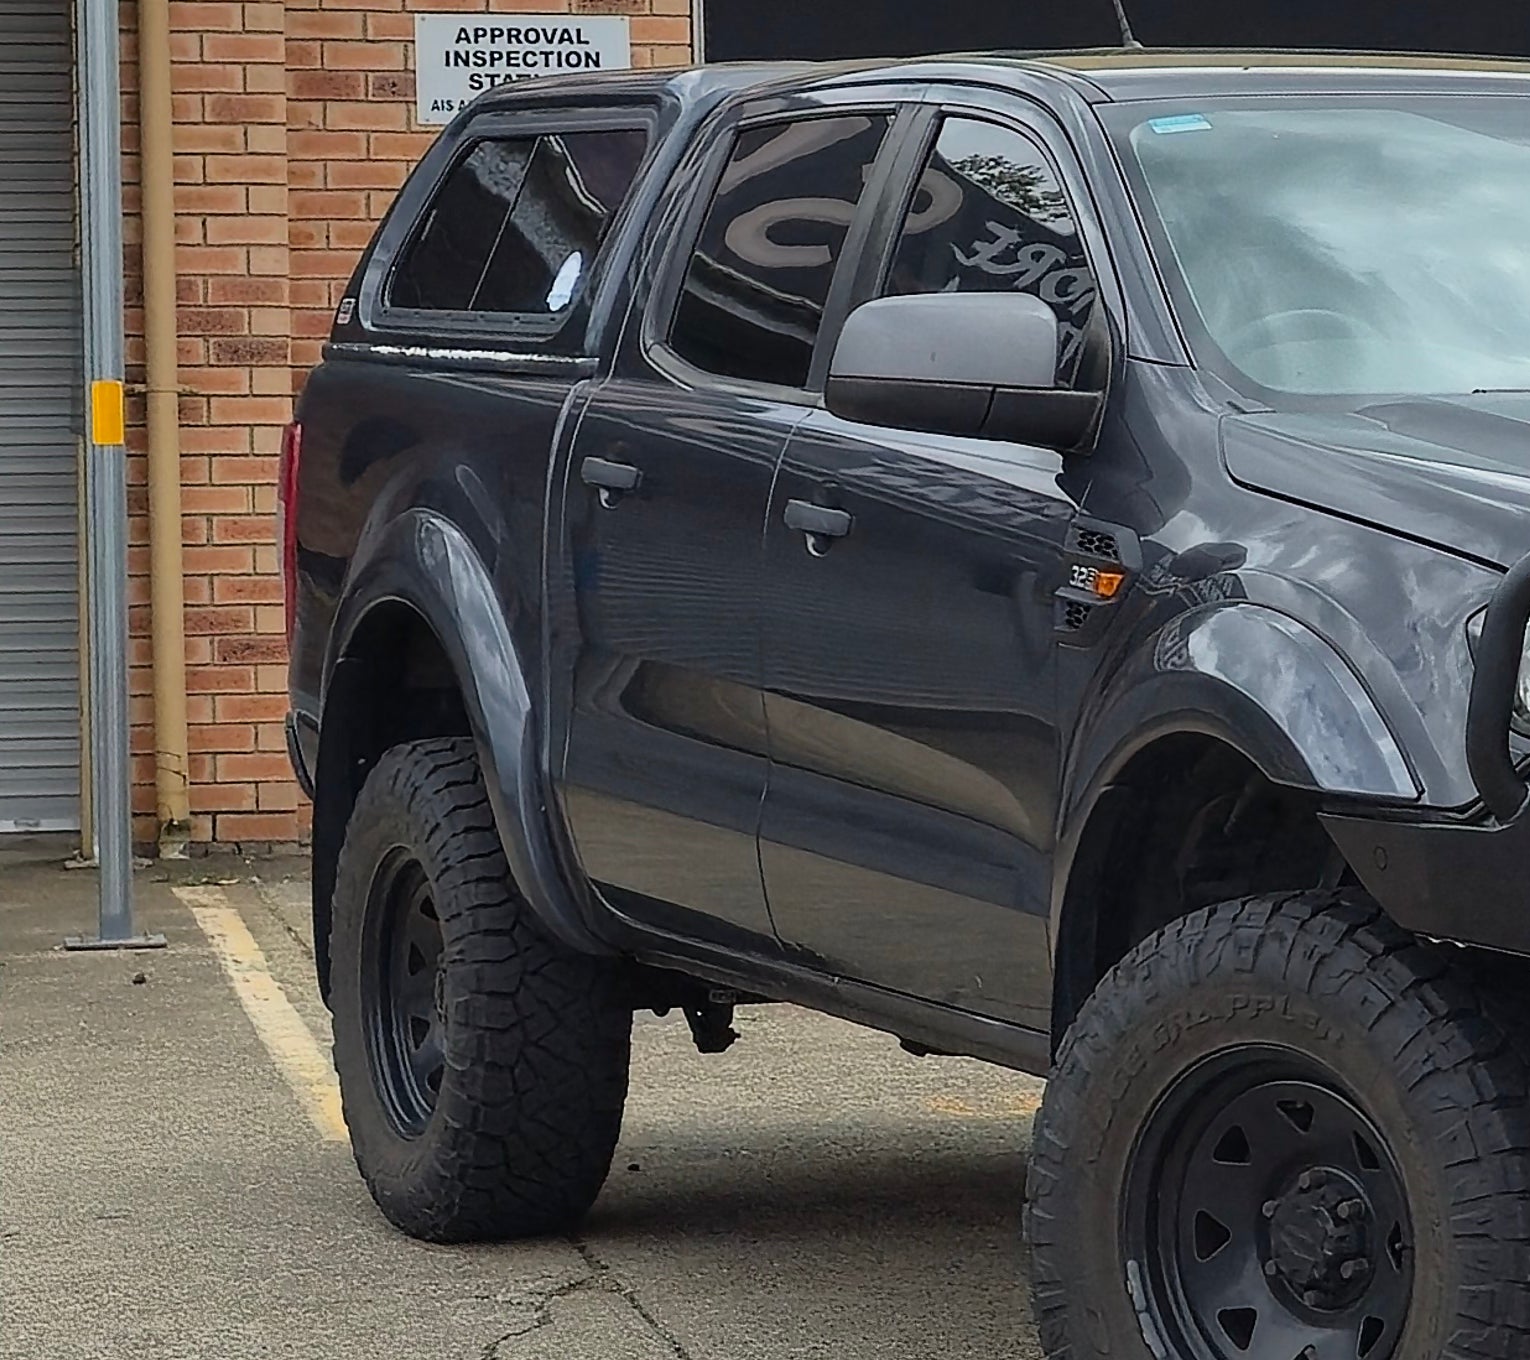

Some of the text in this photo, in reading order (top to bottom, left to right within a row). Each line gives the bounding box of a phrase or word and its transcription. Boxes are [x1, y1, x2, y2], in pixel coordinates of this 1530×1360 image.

[454, 27, 590, 45] APPROVAL
[444, 50, 602, 68] INSPECTION
[431, 99, 454, 111] AIS
